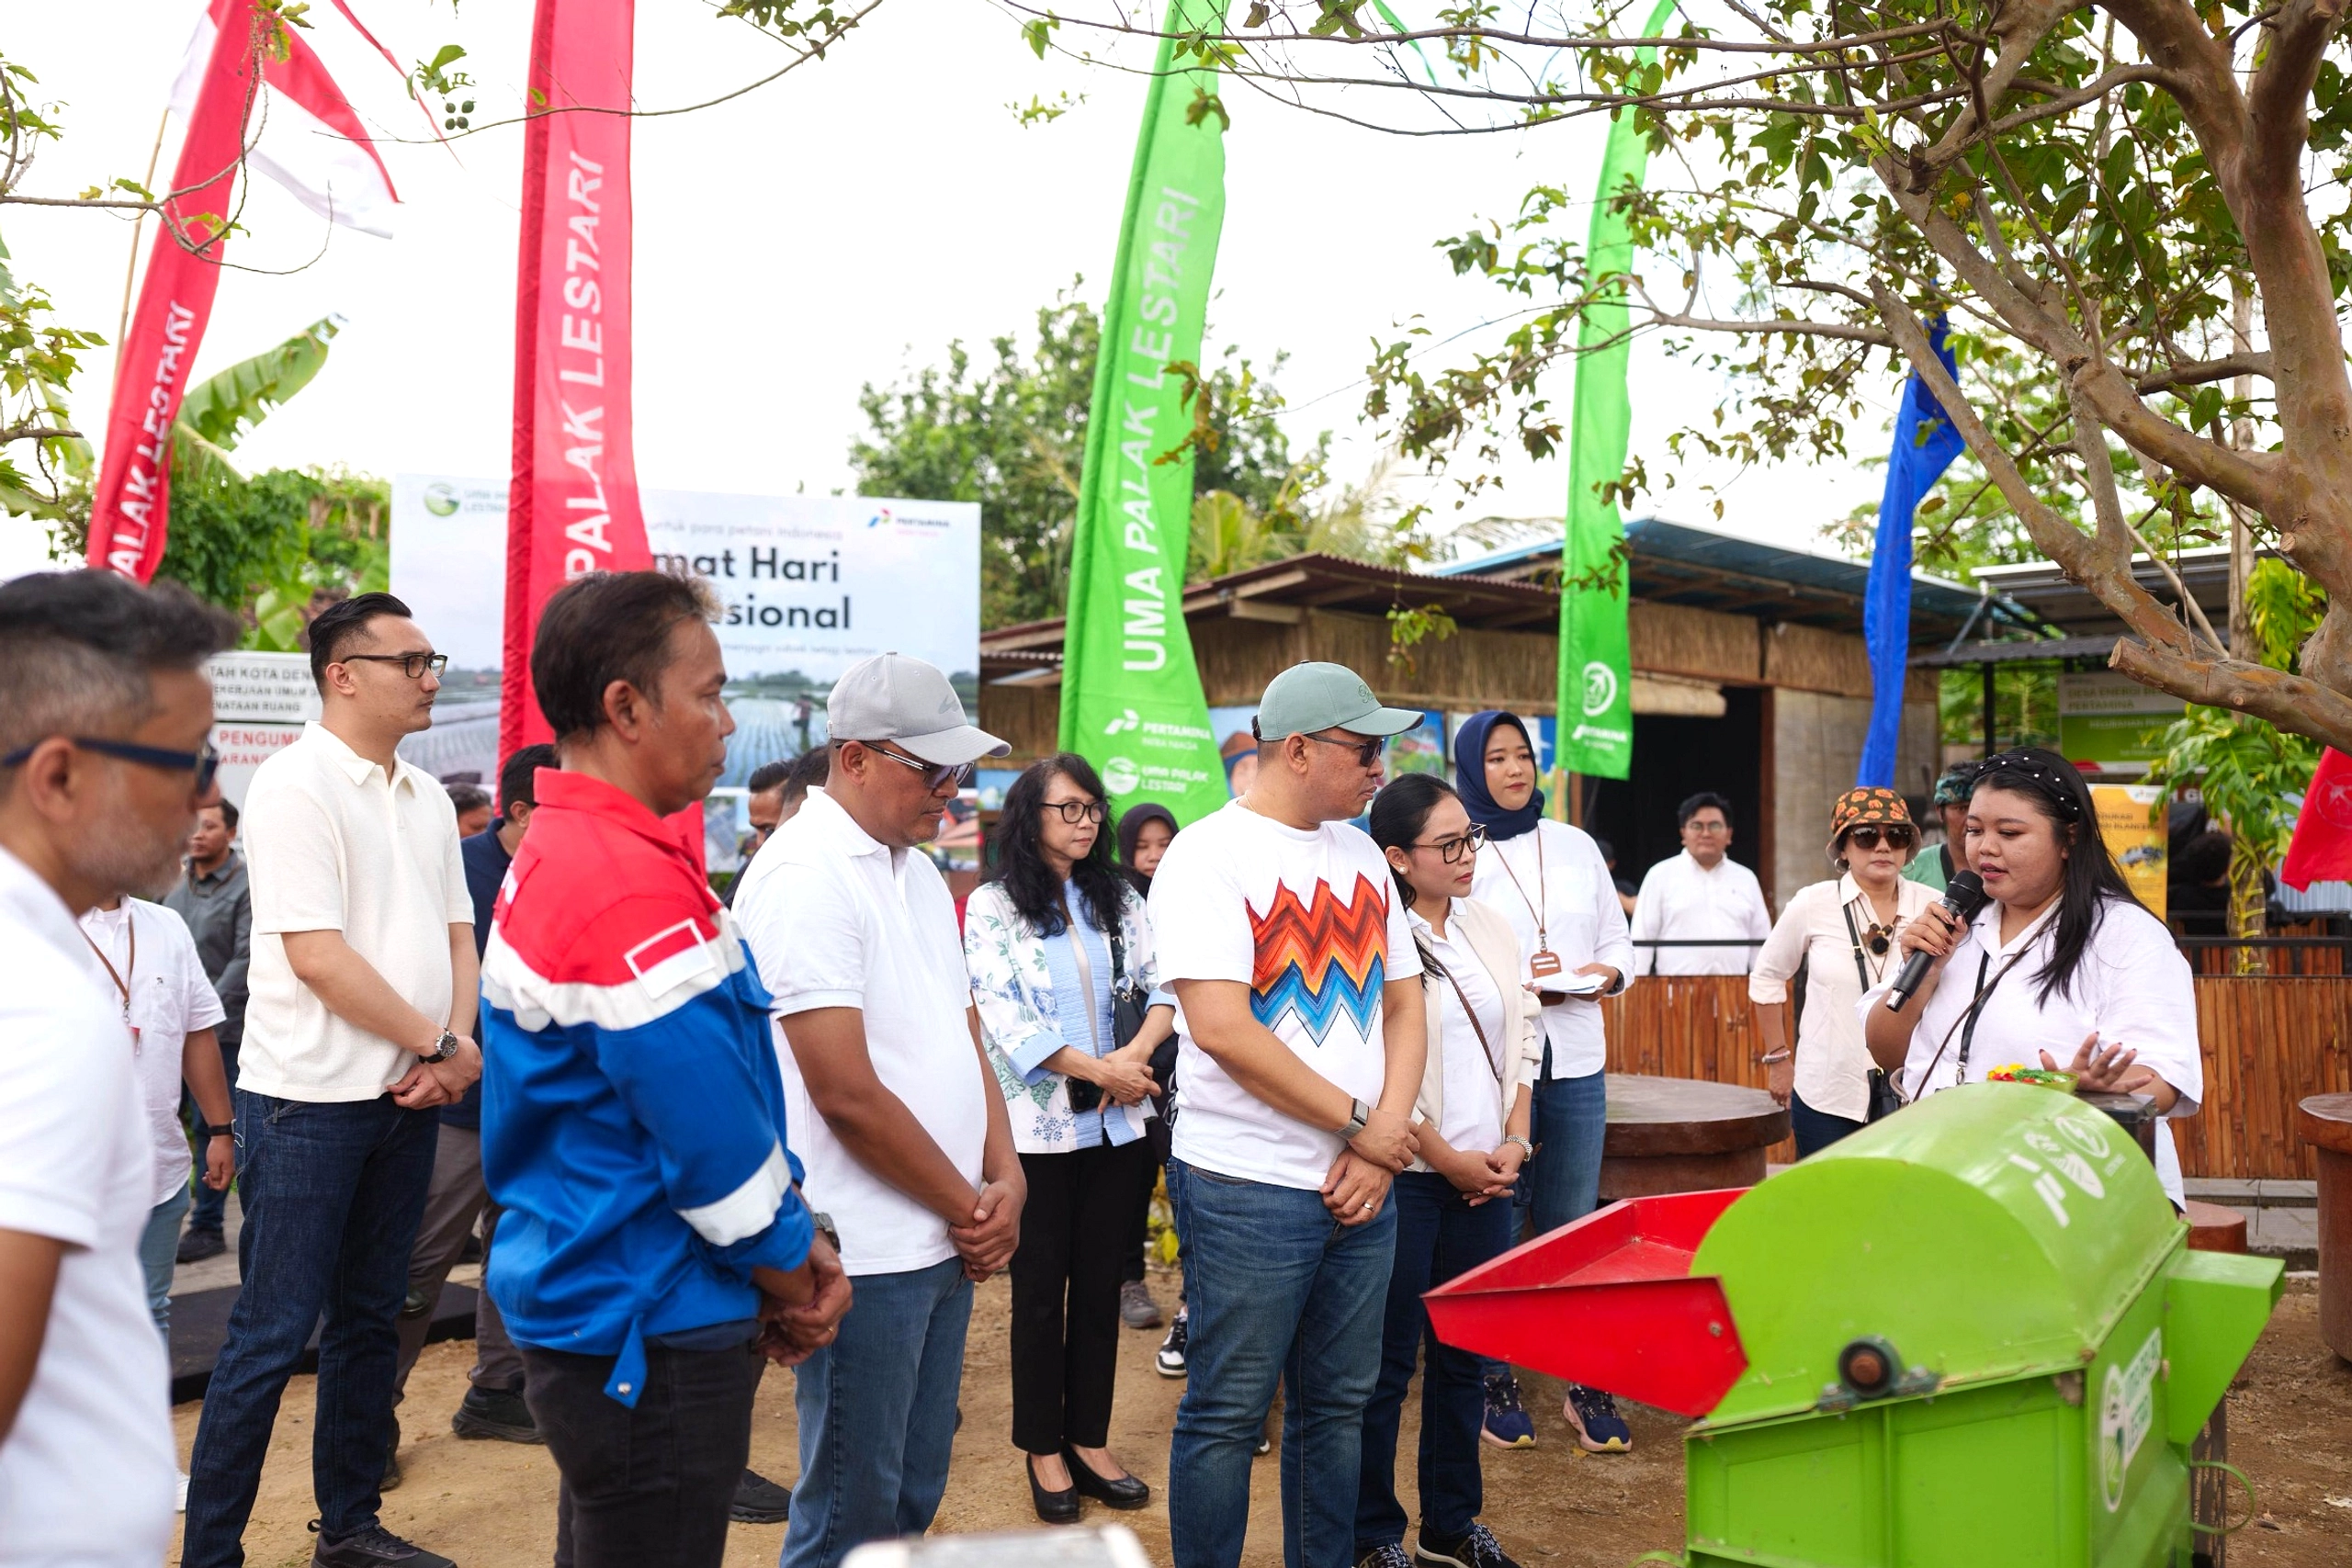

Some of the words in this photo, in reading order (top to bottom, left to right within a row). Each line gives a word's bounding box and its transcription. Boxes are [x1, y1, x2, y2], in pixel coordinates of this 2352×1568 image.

[560, 150, 604, 388] LESTARI
[1126, 186, 1200, 390] LESTARI
[107, 465, 159, 578] ALAK
[136, 299, 196, 465] LESTARI
[561, 398, 613, 581] PALAK
[1121, 400, 1159, 555] PALAK
[653, 548, 735, 579] mat
[750, 546, 838, 582] Hari
[724, 592, 850, 629] sional
[1123, 566, 1167, 672] UMA
[210, 666, 235, 677] TAH
[240, 667, 277, 679] KOTA
[282, 670, 313, 681] DEN
[214, 683, 271, 695] EKERJAAN
[263, 703, 300, 713] RUANG
[1143, 721, 1211, 740] PERTAMINA
